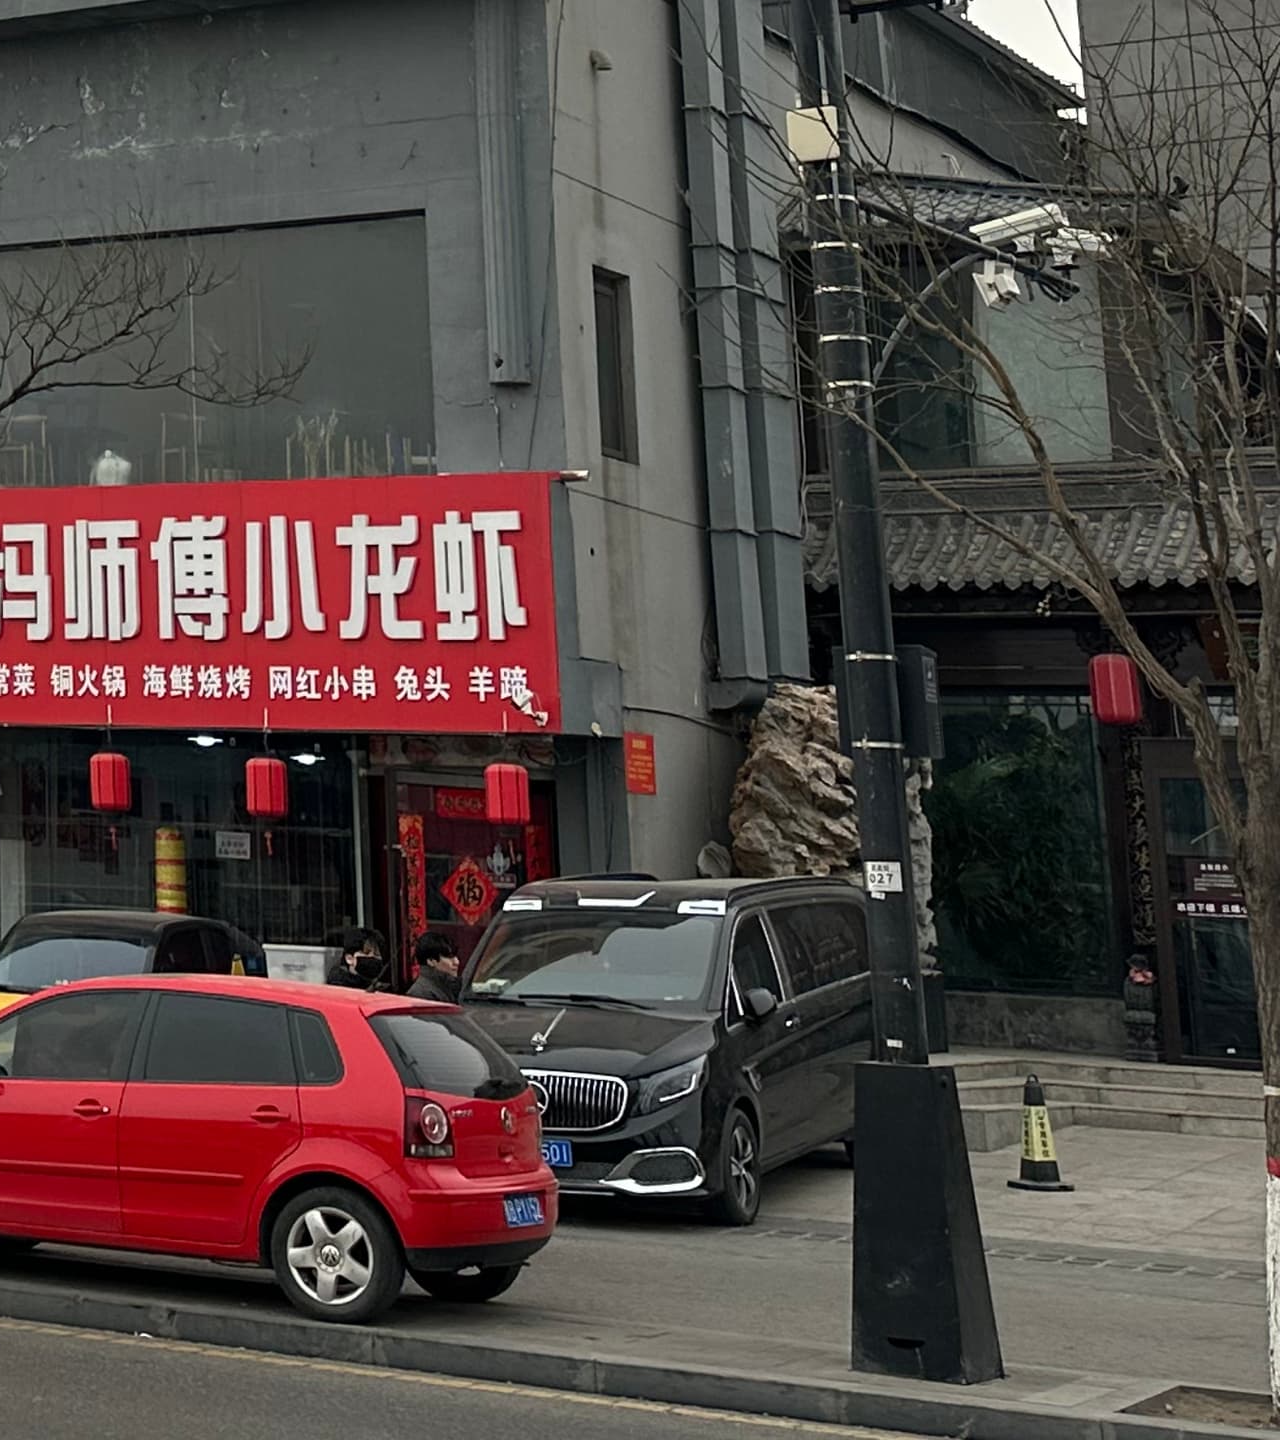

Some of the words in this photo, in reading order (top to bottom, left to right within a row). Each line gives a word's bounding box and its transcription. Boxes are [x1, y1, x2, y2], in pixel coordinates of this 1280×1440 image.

[50, 664, 128, 700] 铜火锅
[142, 665, 252, 701] 海鲜烧烤
[268, 667, 377, 702] 网红小串
[393, 667, 452, 703] 兔头
[455, 874, 485, 907] 福
[869, 872, 894, 884] 027
